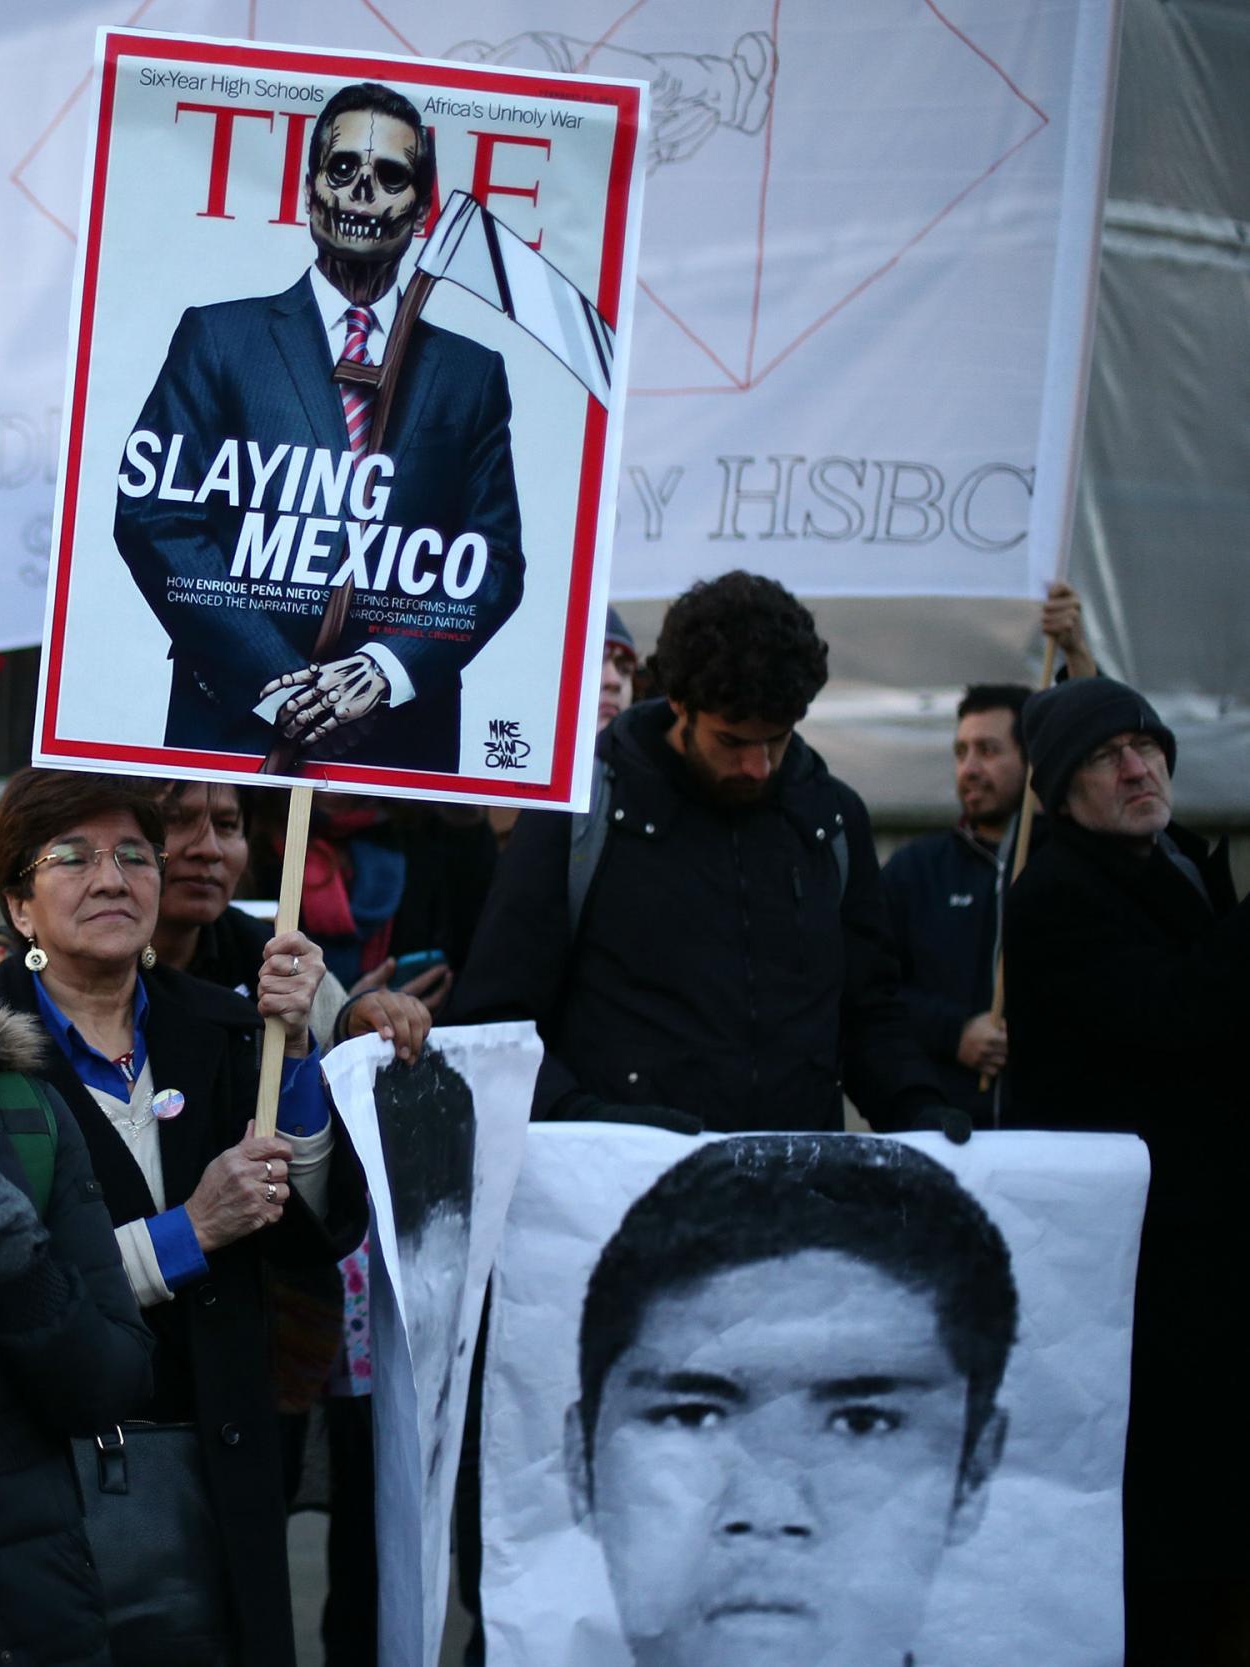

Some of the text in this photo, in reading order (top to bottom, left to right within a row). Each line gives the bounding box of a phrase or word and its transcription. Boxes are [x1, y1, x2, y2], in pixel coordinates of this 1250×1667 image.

[139, 67, 324, 102] Six-Year High Schools
[423, 96, 585, 129] Africa's Unholy War
[174, 102, 551, 252] TIE
[118, 429, 395, 521] SLAYING
[708, 454, 1037, 554] HSBC
[229, 511, 488, 600] MEXICO
[166, 576, 194, 590] HOW
[196, 578, 247, 595] ENRIQUE
[250, 583, 283, 598] PEÑA
[286, 587, 330, 602] NIETO'S
[391, 597, 446, 613] REFORMS
[447, 604, 477, 616] HAVE
[167, 590, 223, 607] CHANGED
[226, 596, 247, 609] THE
[249, 599, 309, 615] NARRATIVE
[311, 603, 324, 616] IN
[434, 616, 476, 630] NATION
